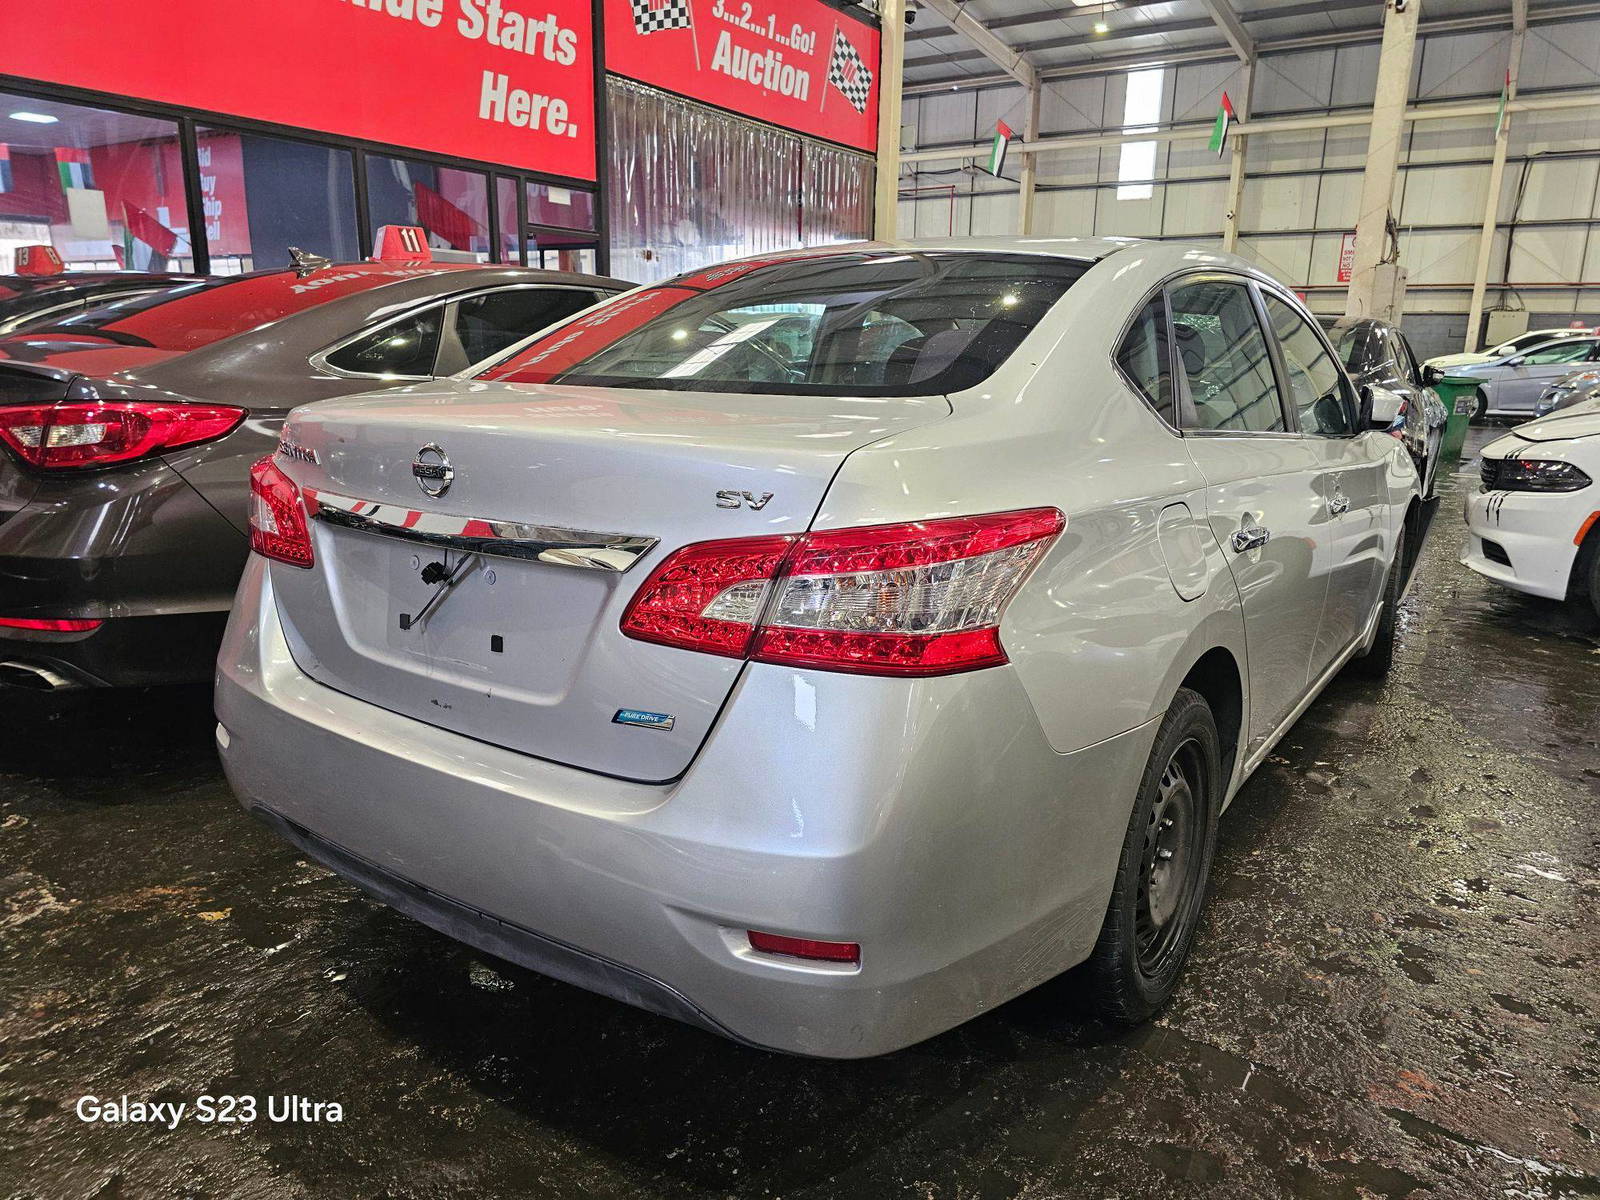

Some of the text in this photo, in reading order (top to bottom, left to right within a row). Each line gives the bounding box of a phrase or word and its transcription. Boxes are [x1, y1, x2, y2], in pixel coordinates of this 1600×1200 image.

[456, 0, 578, 66] Starts
[711, 30, 810, 102] Auction
[479, 70, 578, 138] Here.
[401, 228, 421, 253] 11
[18, 247, 29, 266] 13
[716, 489, 774, 511] SV
[641, 714, 660, 723] DRIVE
